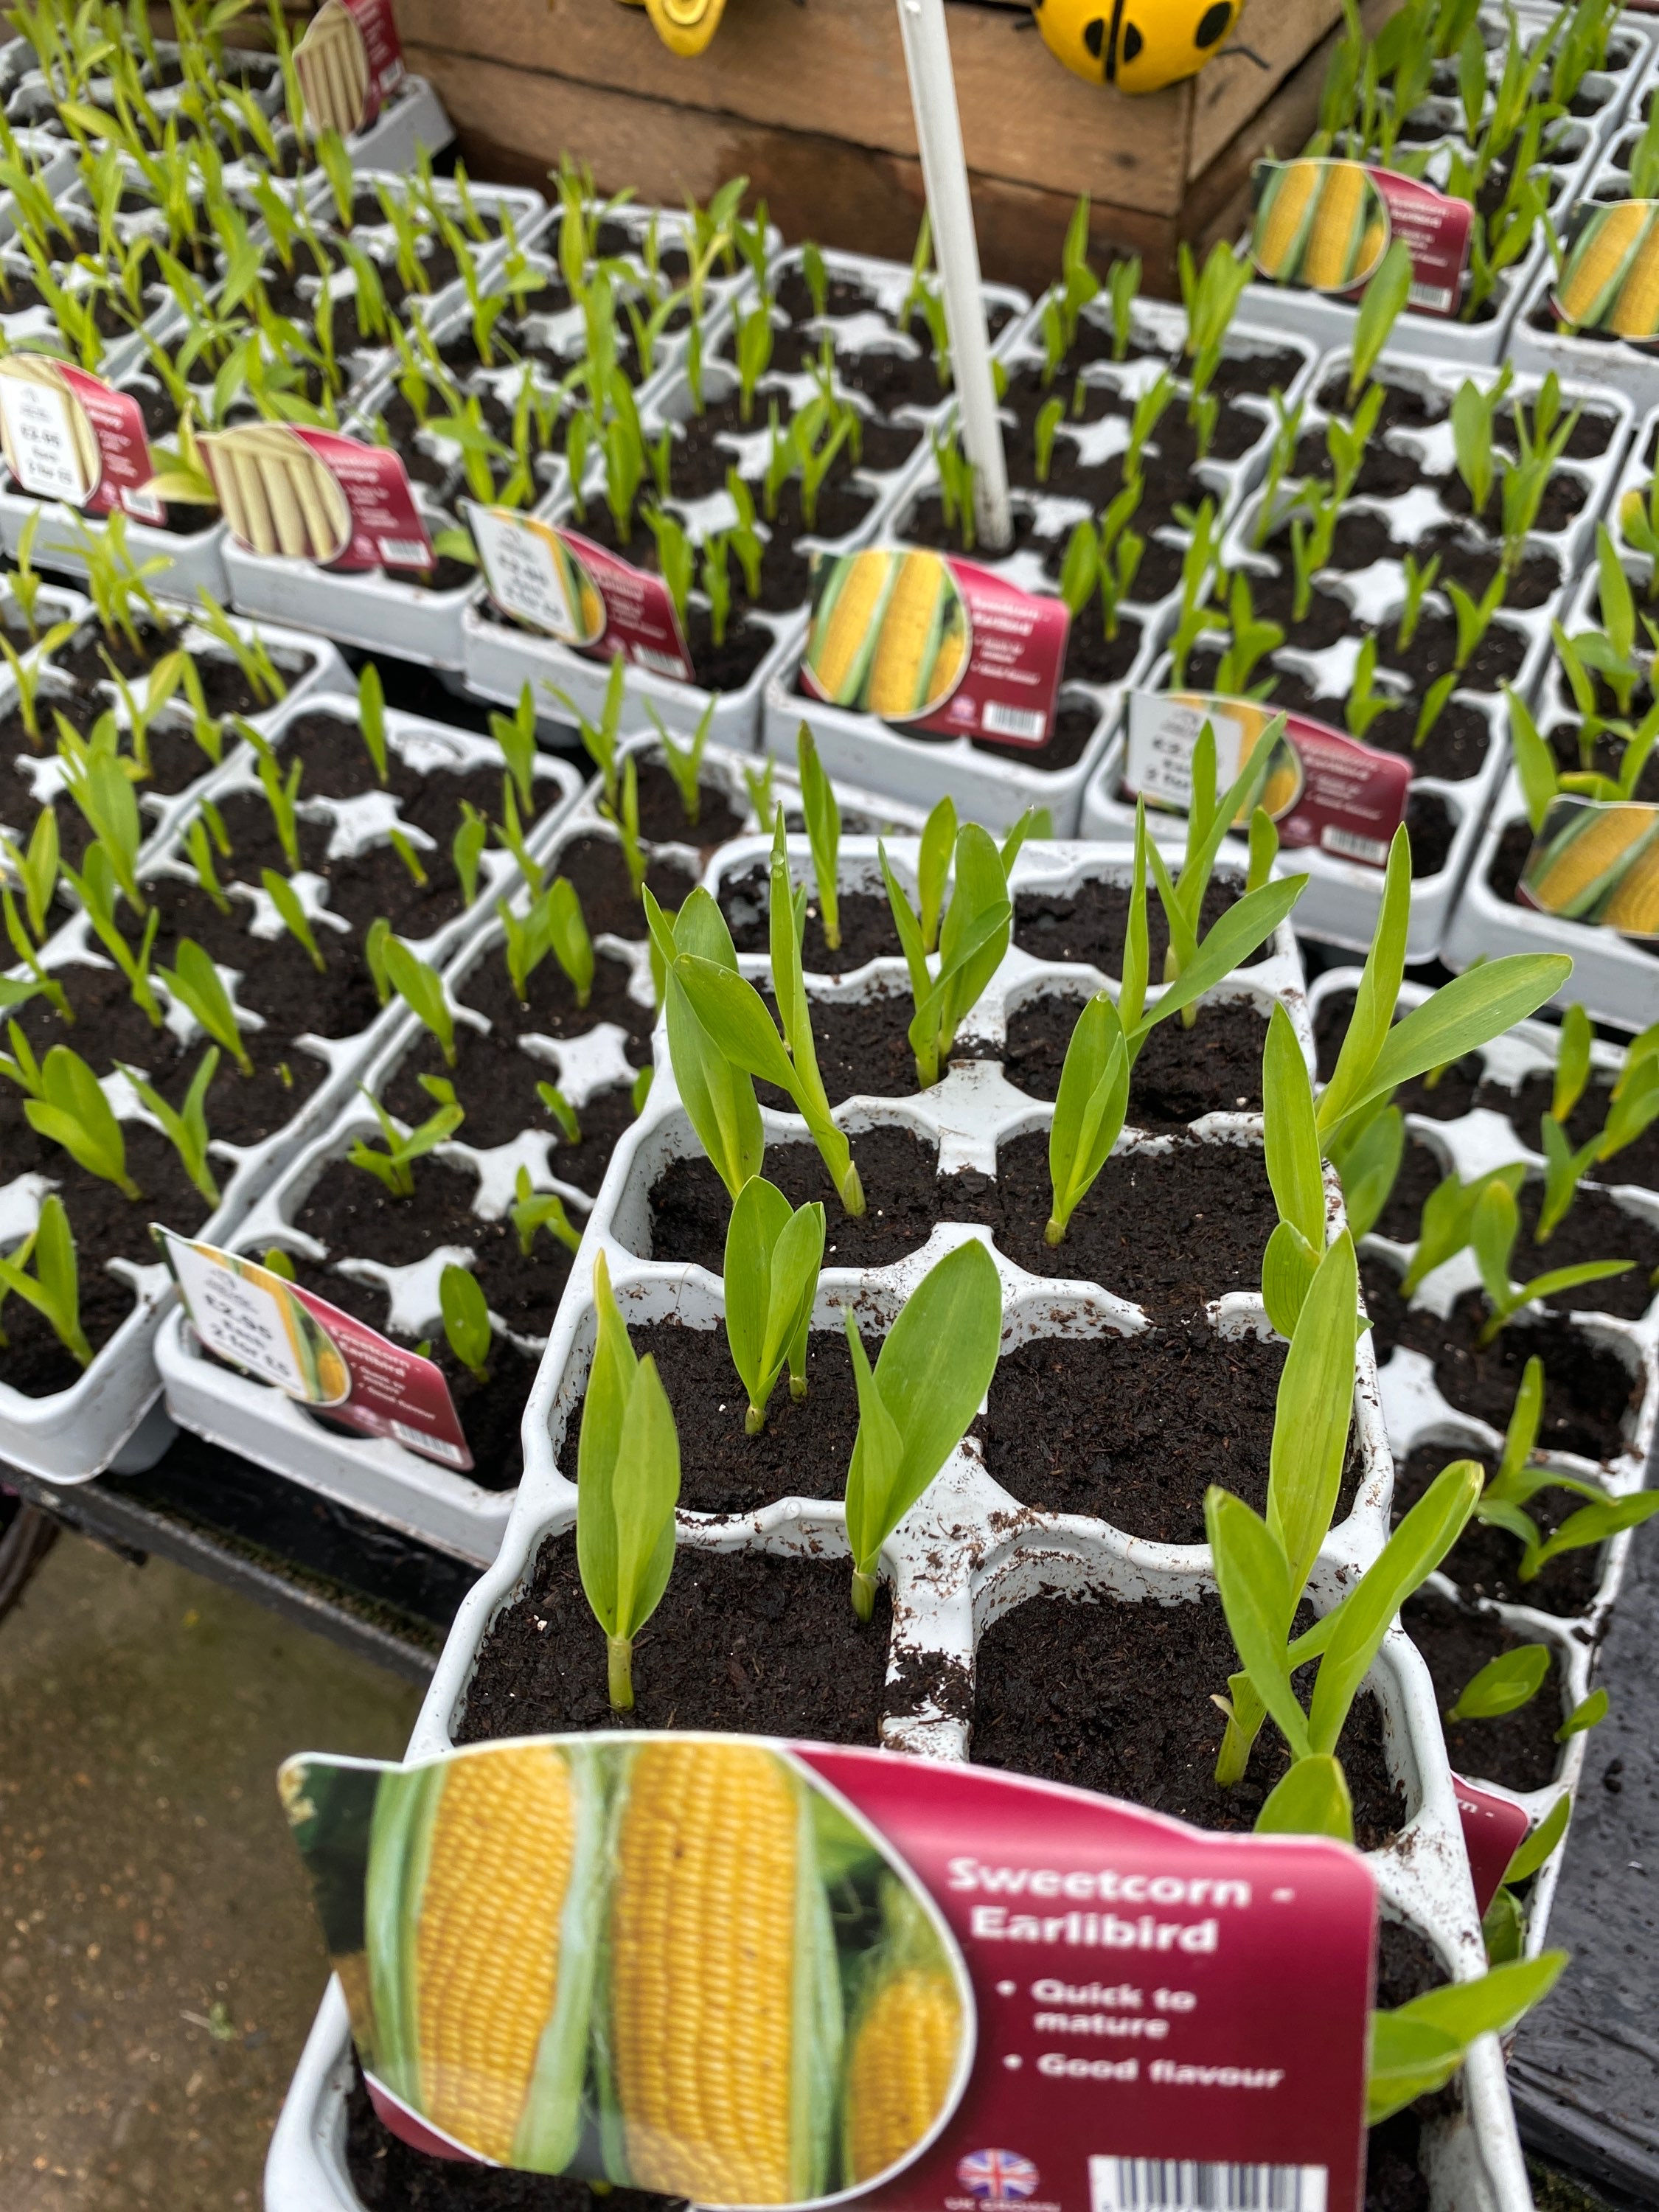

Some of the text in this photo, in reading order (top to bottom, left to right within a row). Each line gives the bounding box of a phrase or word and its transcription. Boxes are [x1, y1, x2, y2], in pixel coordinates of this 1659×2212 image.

[948, 1857, 1251, 1908] Sweetcorn
[970, 1905, 1219, 1952] Earlibird
[1031, 1979, 1196, 2011] Quick to
[1034, 2012, 1169, 2039] mature
[1037, 2052, 1284, 2089] Good flavour
